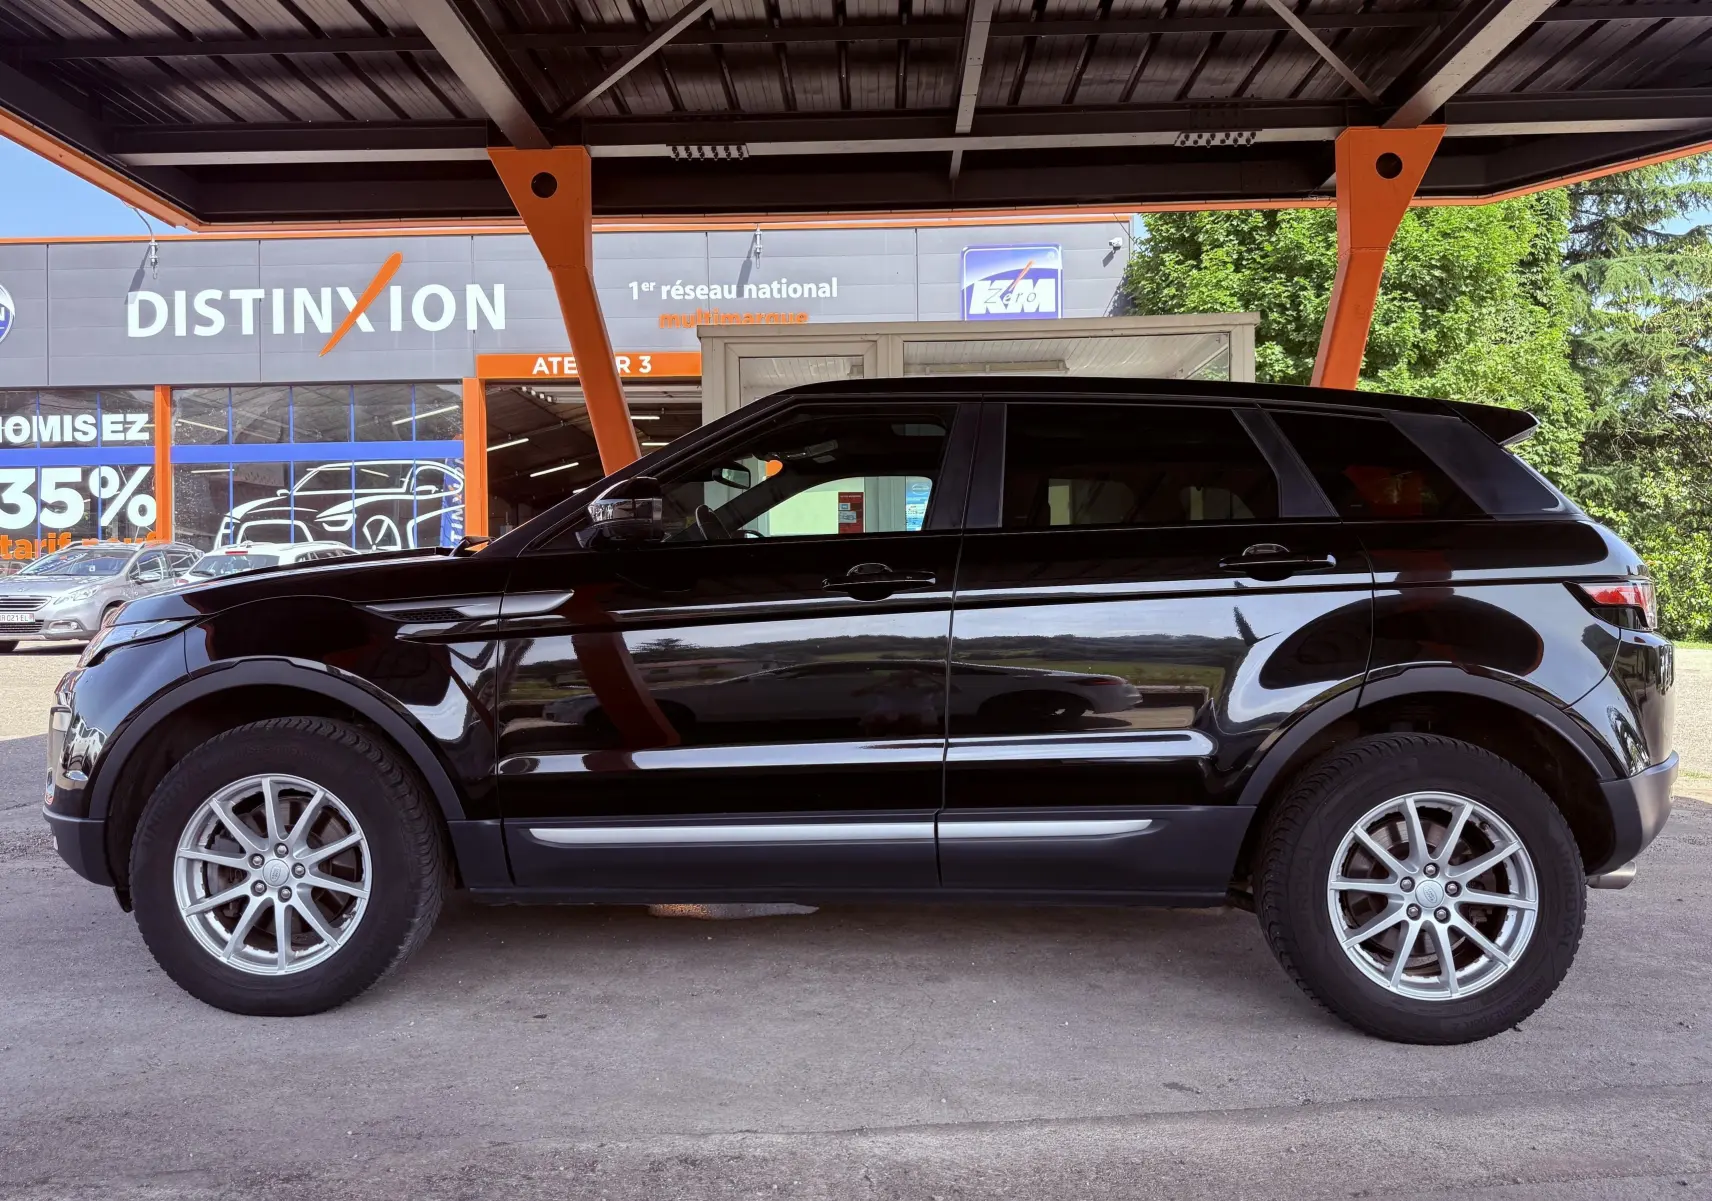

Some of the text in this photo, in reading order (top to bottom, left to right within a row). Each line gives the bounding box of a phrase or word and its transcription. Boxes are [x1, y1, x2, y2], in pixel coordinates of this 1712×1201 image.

[628, 277, 838, 300] 1er réseau national
[128, 253, 505, 356] DISTINXION
[659, 307, 809, 329] multimarque
[532, 356, 652, 375] ATER 3
[0, 414, 150, 444] OMISEZ
[0, 532, 72, 560] tarif
